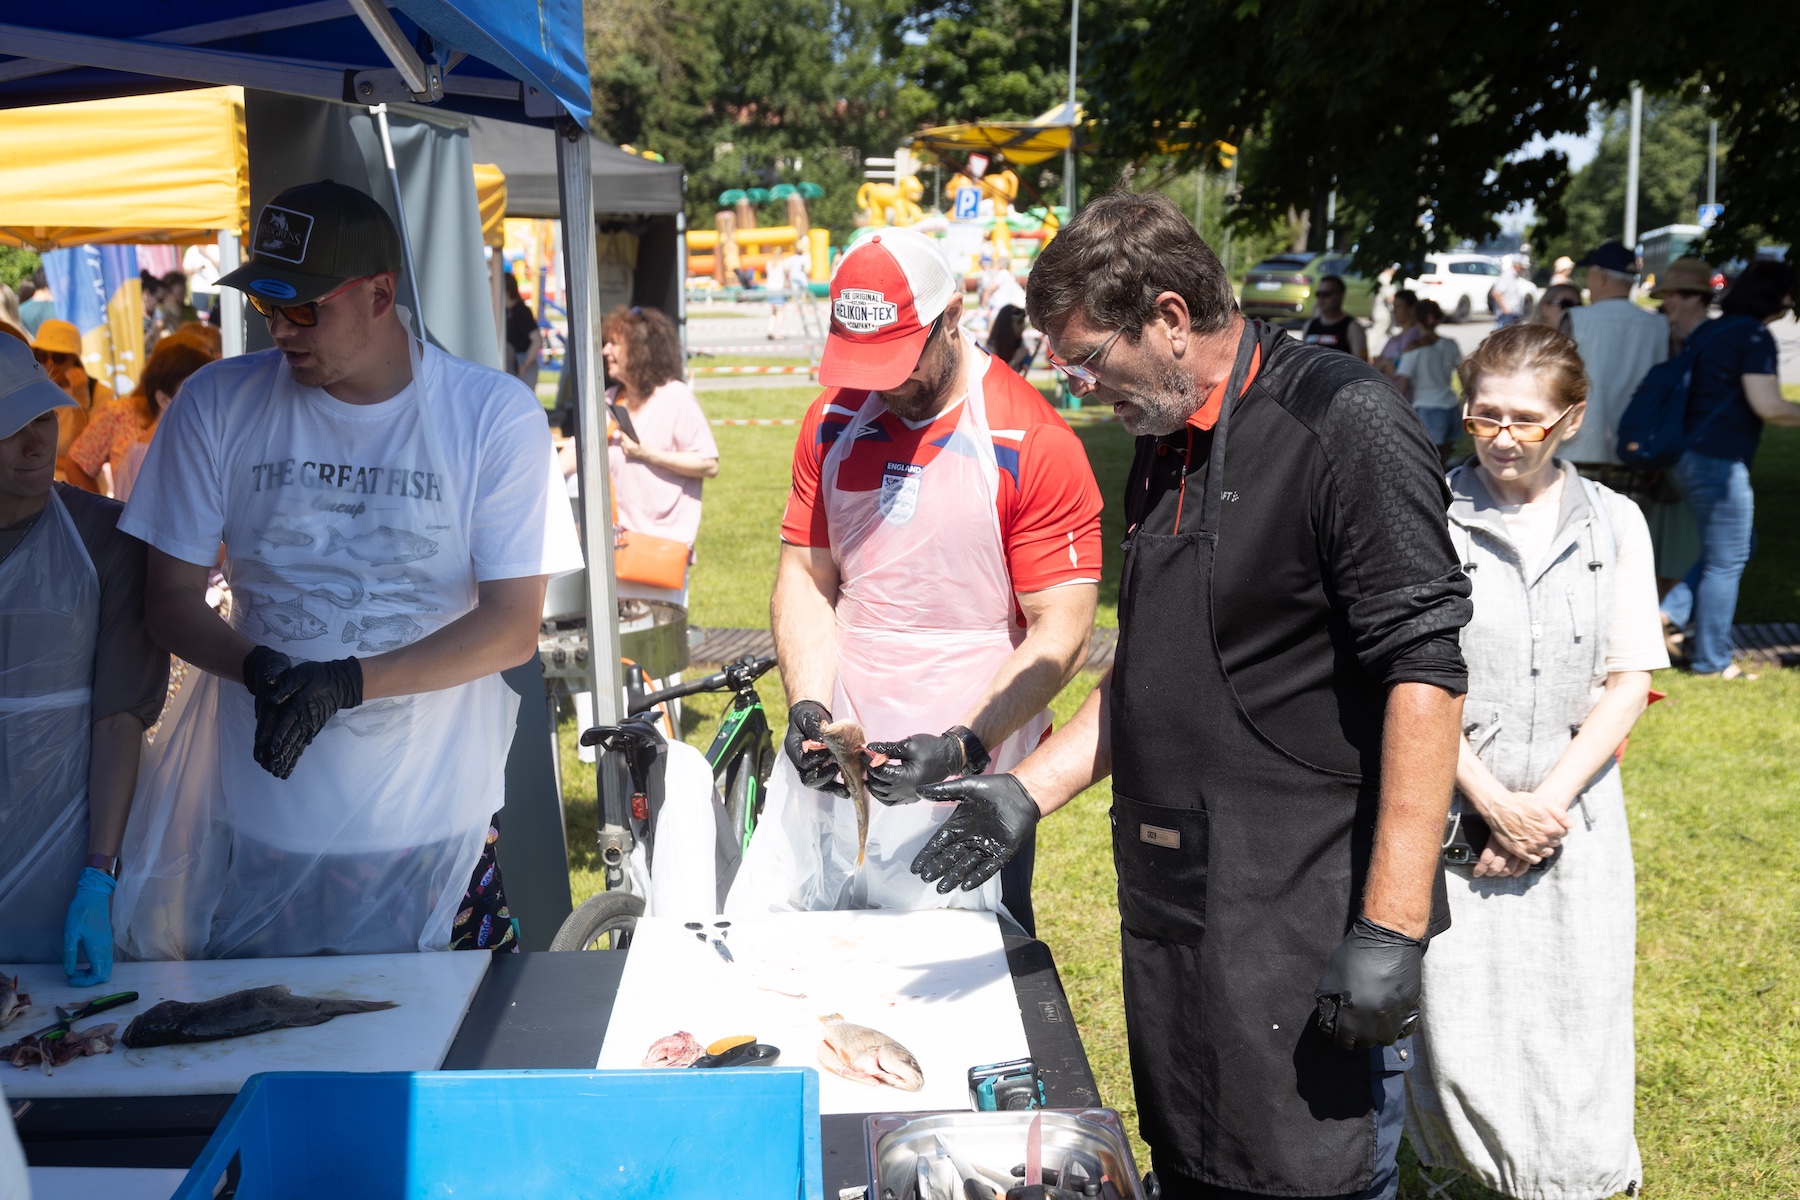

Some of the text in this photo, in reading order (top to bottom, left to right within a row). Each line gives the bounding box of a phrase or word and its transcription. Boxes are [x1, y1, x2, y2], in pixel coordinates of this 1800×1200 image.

[958, 189, 977, 217] P
[842, 292, 880, 302] THE ORIGINAL
[836, 303, 892, 321] HELIKON-TEX
[887, 462, 922, 474] ENGLAND
[252, 458, 446, 502] THE GREAT FISH
[310, 494, 367, 519] lineup
